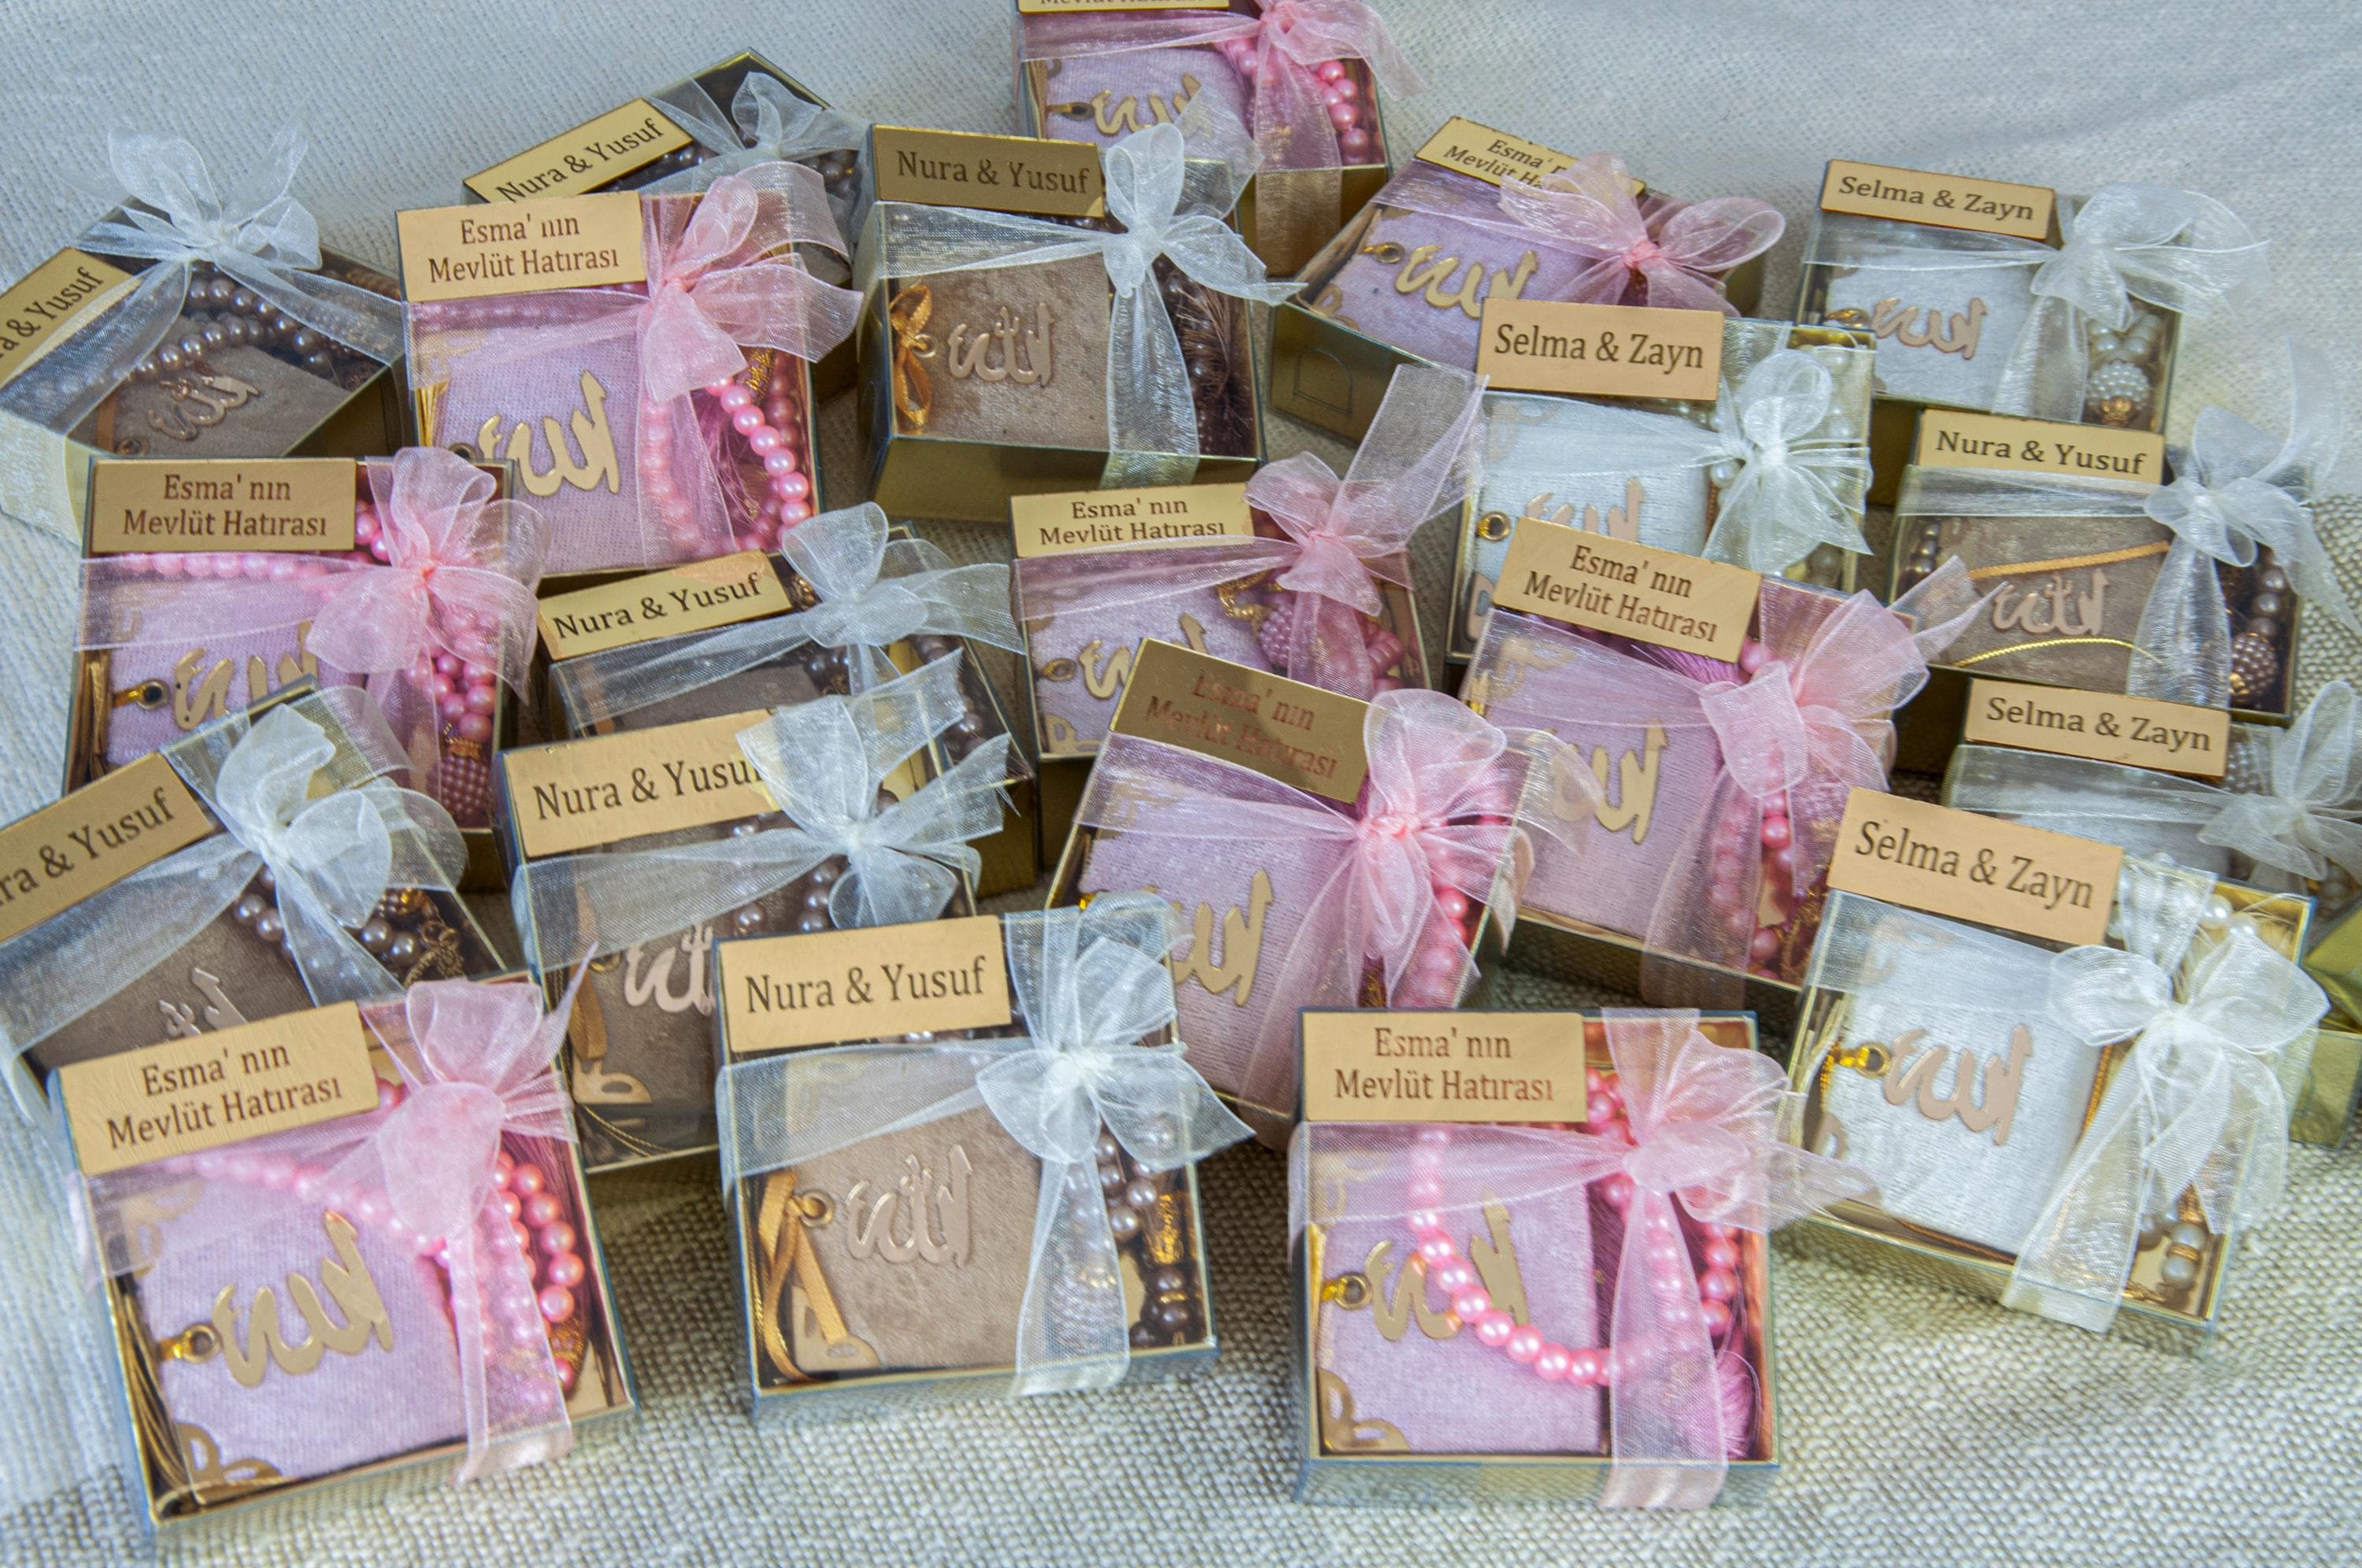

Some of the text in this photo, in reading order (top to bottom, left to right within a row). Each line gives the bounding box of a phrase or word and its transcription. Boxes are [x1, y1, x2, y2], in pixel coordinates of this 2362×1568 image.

[496, 118, 664, 202] Nura & Yusuf
[897, 150, 1090, 194] Nura & Yusuf
[1838, 176, 2034, 220] Selma & Zayn
[429, 249, 618, 283] Mevlüt Hatırası
[6, 266, 104, 337] & Yusuf
[1494, 324, 1703, 375] Selma & Zayn
[1936, 431, 2148, 475] Nura & Yusuf
[123, 509, 327, 537] Mevlüt Hatırası
[1039, 522, 1225, 545] Mevlüt Hatırası
[553, 571, 761, 639] Nura & Yusuf
[1522, 571, 1717, 643] Mevlüt Hatırası
[1986, 697, 2212, 752] Selma & Zayn
[533, 782, 622, 820] Nura
[631, 767, 659, 804] &
[39, 845, 75, 878] &
[68, 786, 175, 860] Yusuf
[1855, 820, 2094, 910] Selma & Zayn
[745, 955, 987, 1014] Nura & Yusuf
[1335, 1068, 1554, 1102] Mevlüt Hatırası
[107, 1076, 342, 1151] Mevlüt Hatırası
